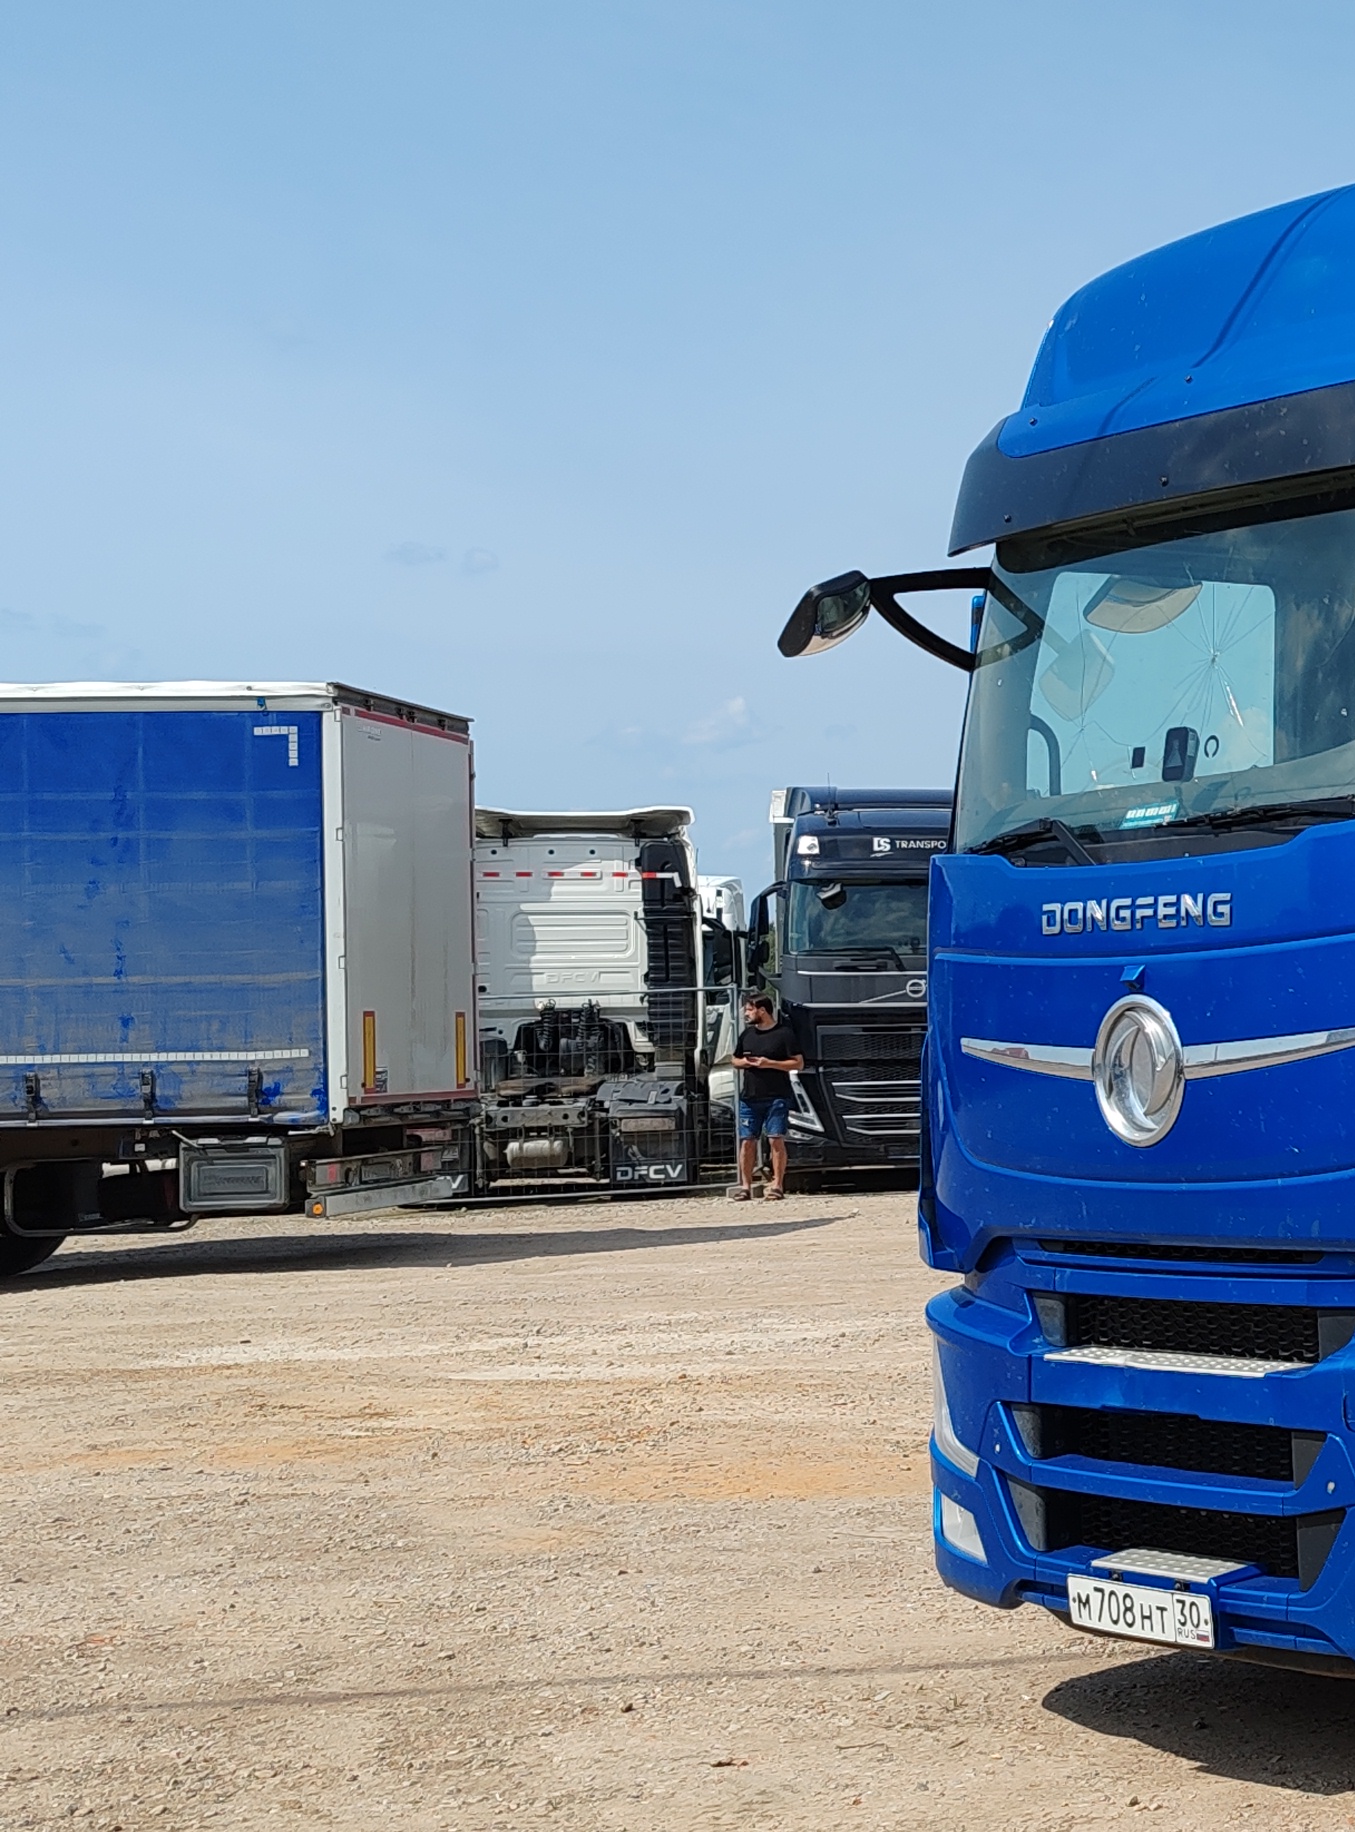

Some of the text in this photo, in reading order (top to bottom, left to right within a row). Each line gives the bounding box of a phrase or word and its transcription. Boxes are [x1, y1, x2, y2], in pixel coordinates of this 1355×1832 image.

[1042, 892, 1232, 936] DONGFENG
[616, 1164, 683, 1181] DFCV
[1176, 1598, 1201, 1629] 30
[1176, 1627, 1196, 1640] RUS
